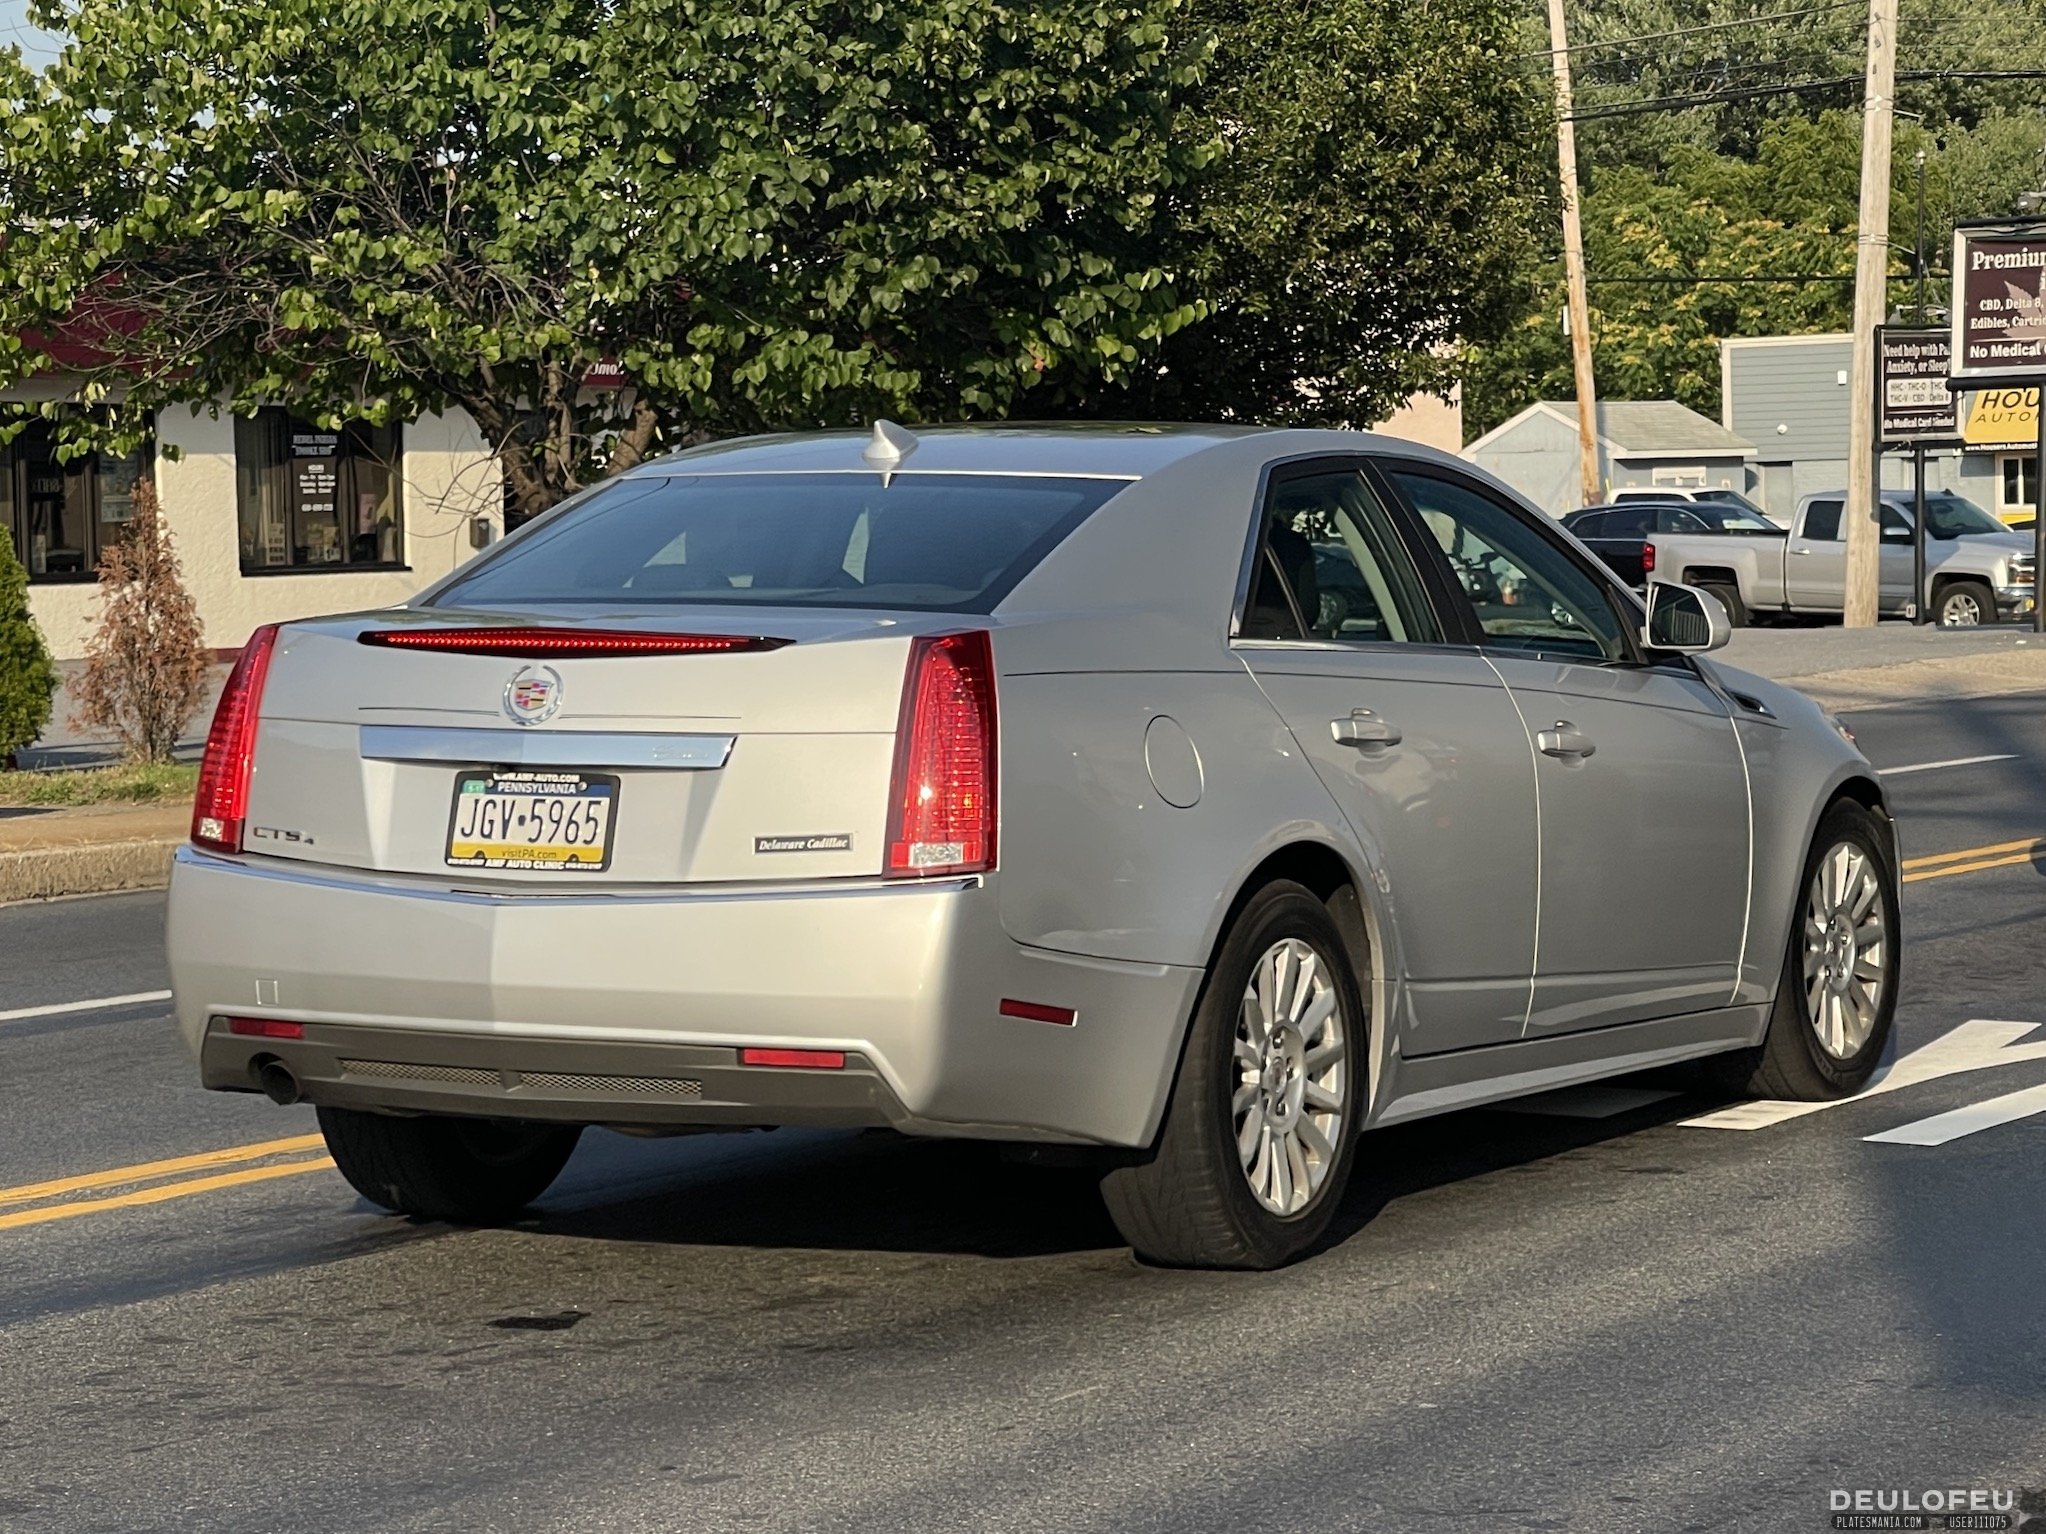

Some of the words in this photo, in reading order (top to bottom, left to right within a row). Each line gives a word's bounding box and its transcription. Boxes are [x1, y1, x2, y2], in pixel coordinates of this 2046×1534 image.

[1980, 299, 2004, 312] CBD,
[2005, 297, 2032, 310] Delta
[1970, 318, 2010, 330] Edibles,
[1884, 344, 1903, 357] Need
[1903, 344, 1920, 359] help
[1920, 343, 1938, 356] with
[1970, 345, 1988, 358] No
[1991, 342, 2041, 358] Medical
[1886, 360, 1917, 375] Anxiety,
[1917, 362, 1928, 372] or
[498, 781, 577, 794] PENNSYLVANIA
[759, 840, 805, 850] Delaware
[807, 837, 848, 849] Cadillac
[502, 849, 557, 860] visitPA.com
[506, 861, 532, 869] AUTO
[533, 861, 565, 870] CLINIC
